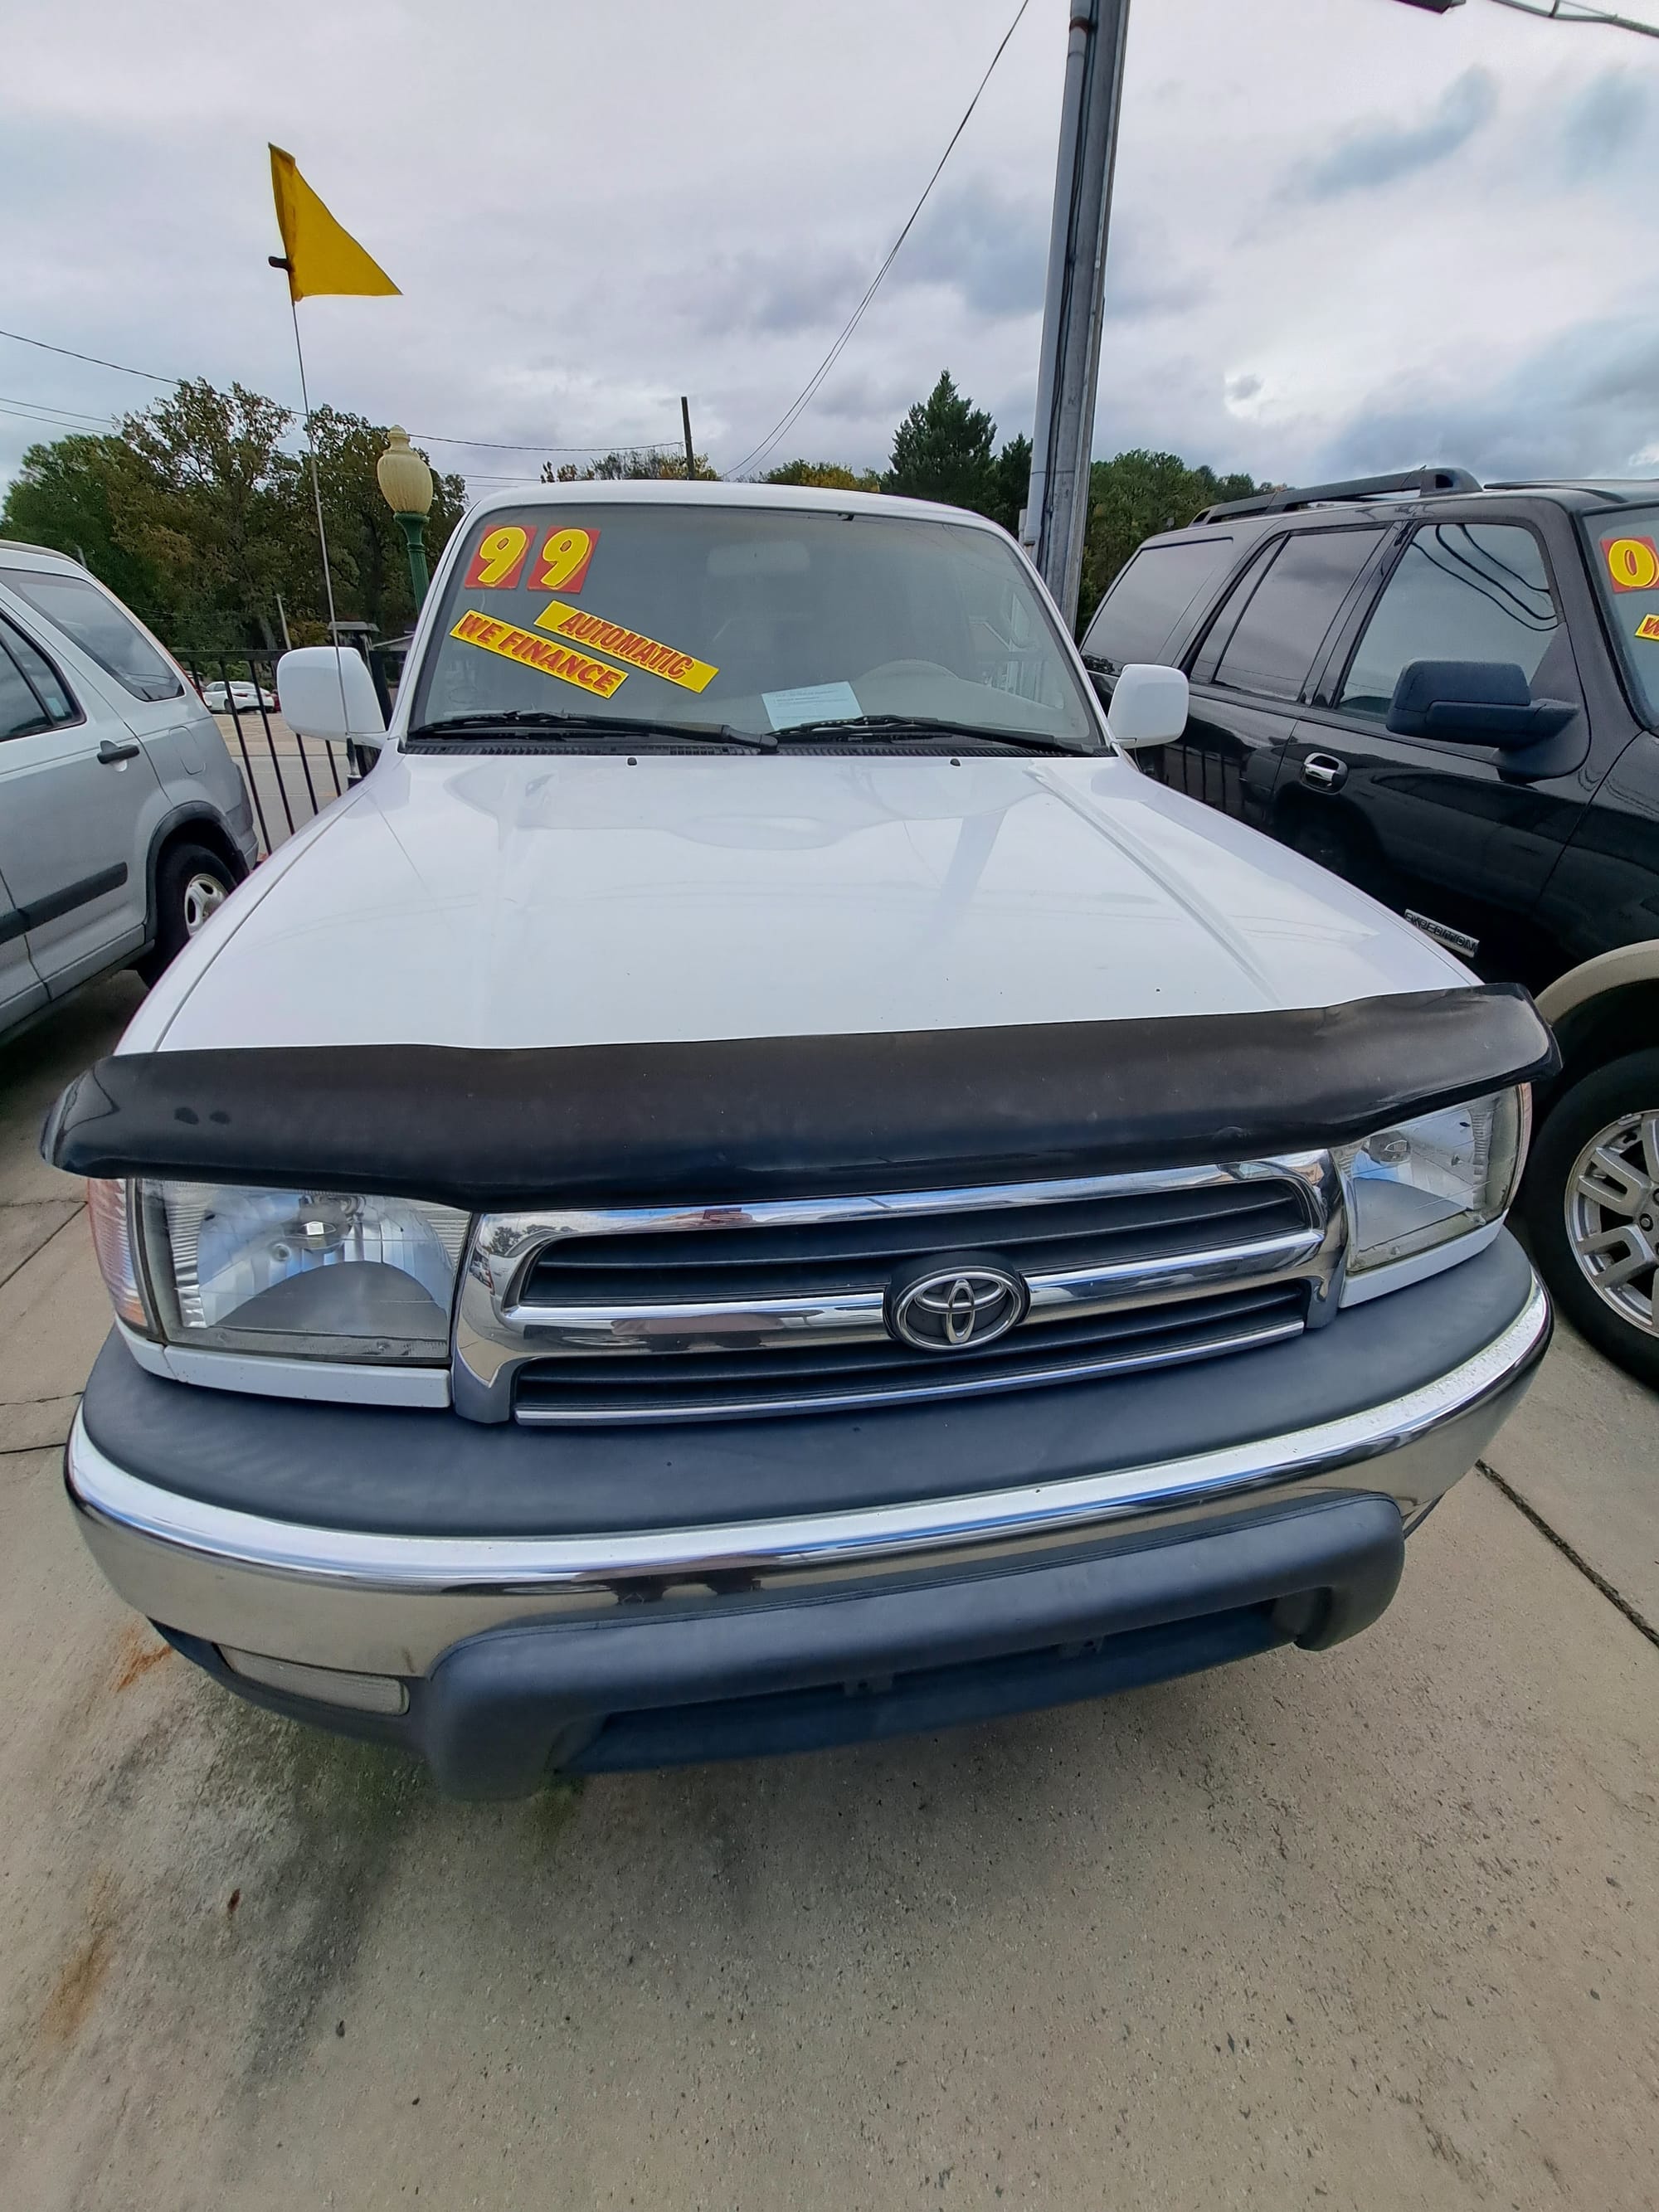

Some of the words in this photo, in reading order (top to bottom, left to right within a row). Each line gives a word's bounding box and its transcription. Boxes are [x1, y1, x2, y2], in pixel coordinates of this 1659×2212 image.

[456, 613, 502, 644] WE
[498, 630, 622, 692] FINANCE
[557, 611, 694, 680] AUTOMATIC
[1405, 912, 1477, 951] EXPEDITION
